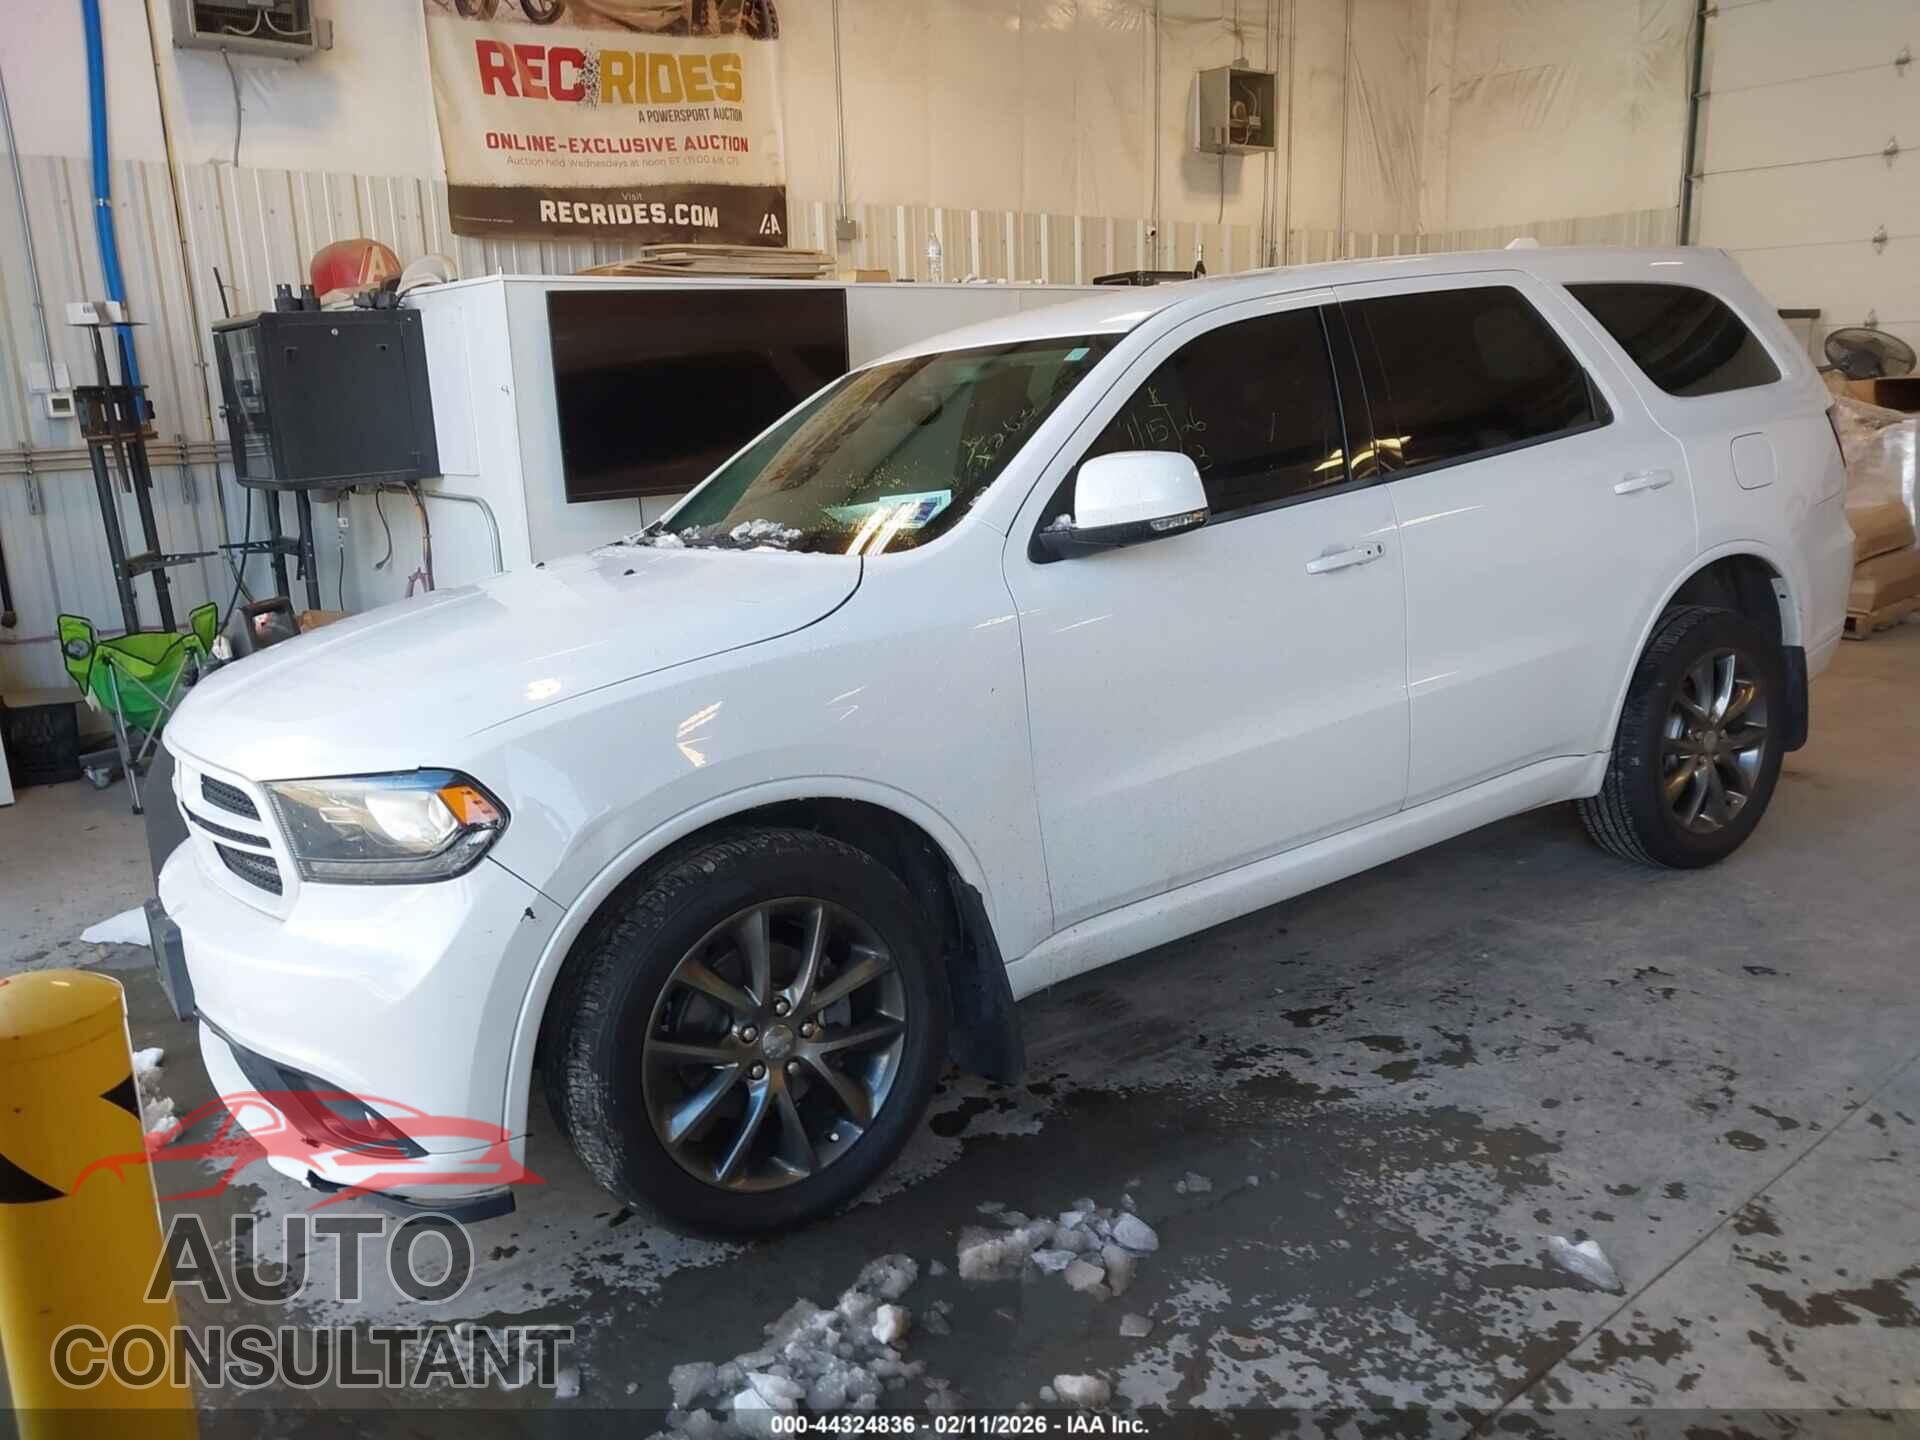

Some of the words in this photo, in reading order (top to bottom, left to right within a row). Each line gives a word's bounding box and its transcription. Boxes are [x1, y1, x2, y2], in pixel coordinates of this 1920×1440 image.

[475, 39, 586, 101] REC
[600, 49, 743, 104] RIDES
[638, 110, 645, 123] A
[647, 108, 709, 123] POWERSPORT
[714, 107, 742, 121] AUCTION
[486, 132, 677, 153] ONLINE-EXCLUSIVE
[684, 135, 748, 152] AUCTION
[507, 155, 542, 168] Auction
[643, 159, 666, 168] noon
[620, 191, 643, 201] Visit
[539, 200, 719, 228] RECRIDES.COM
